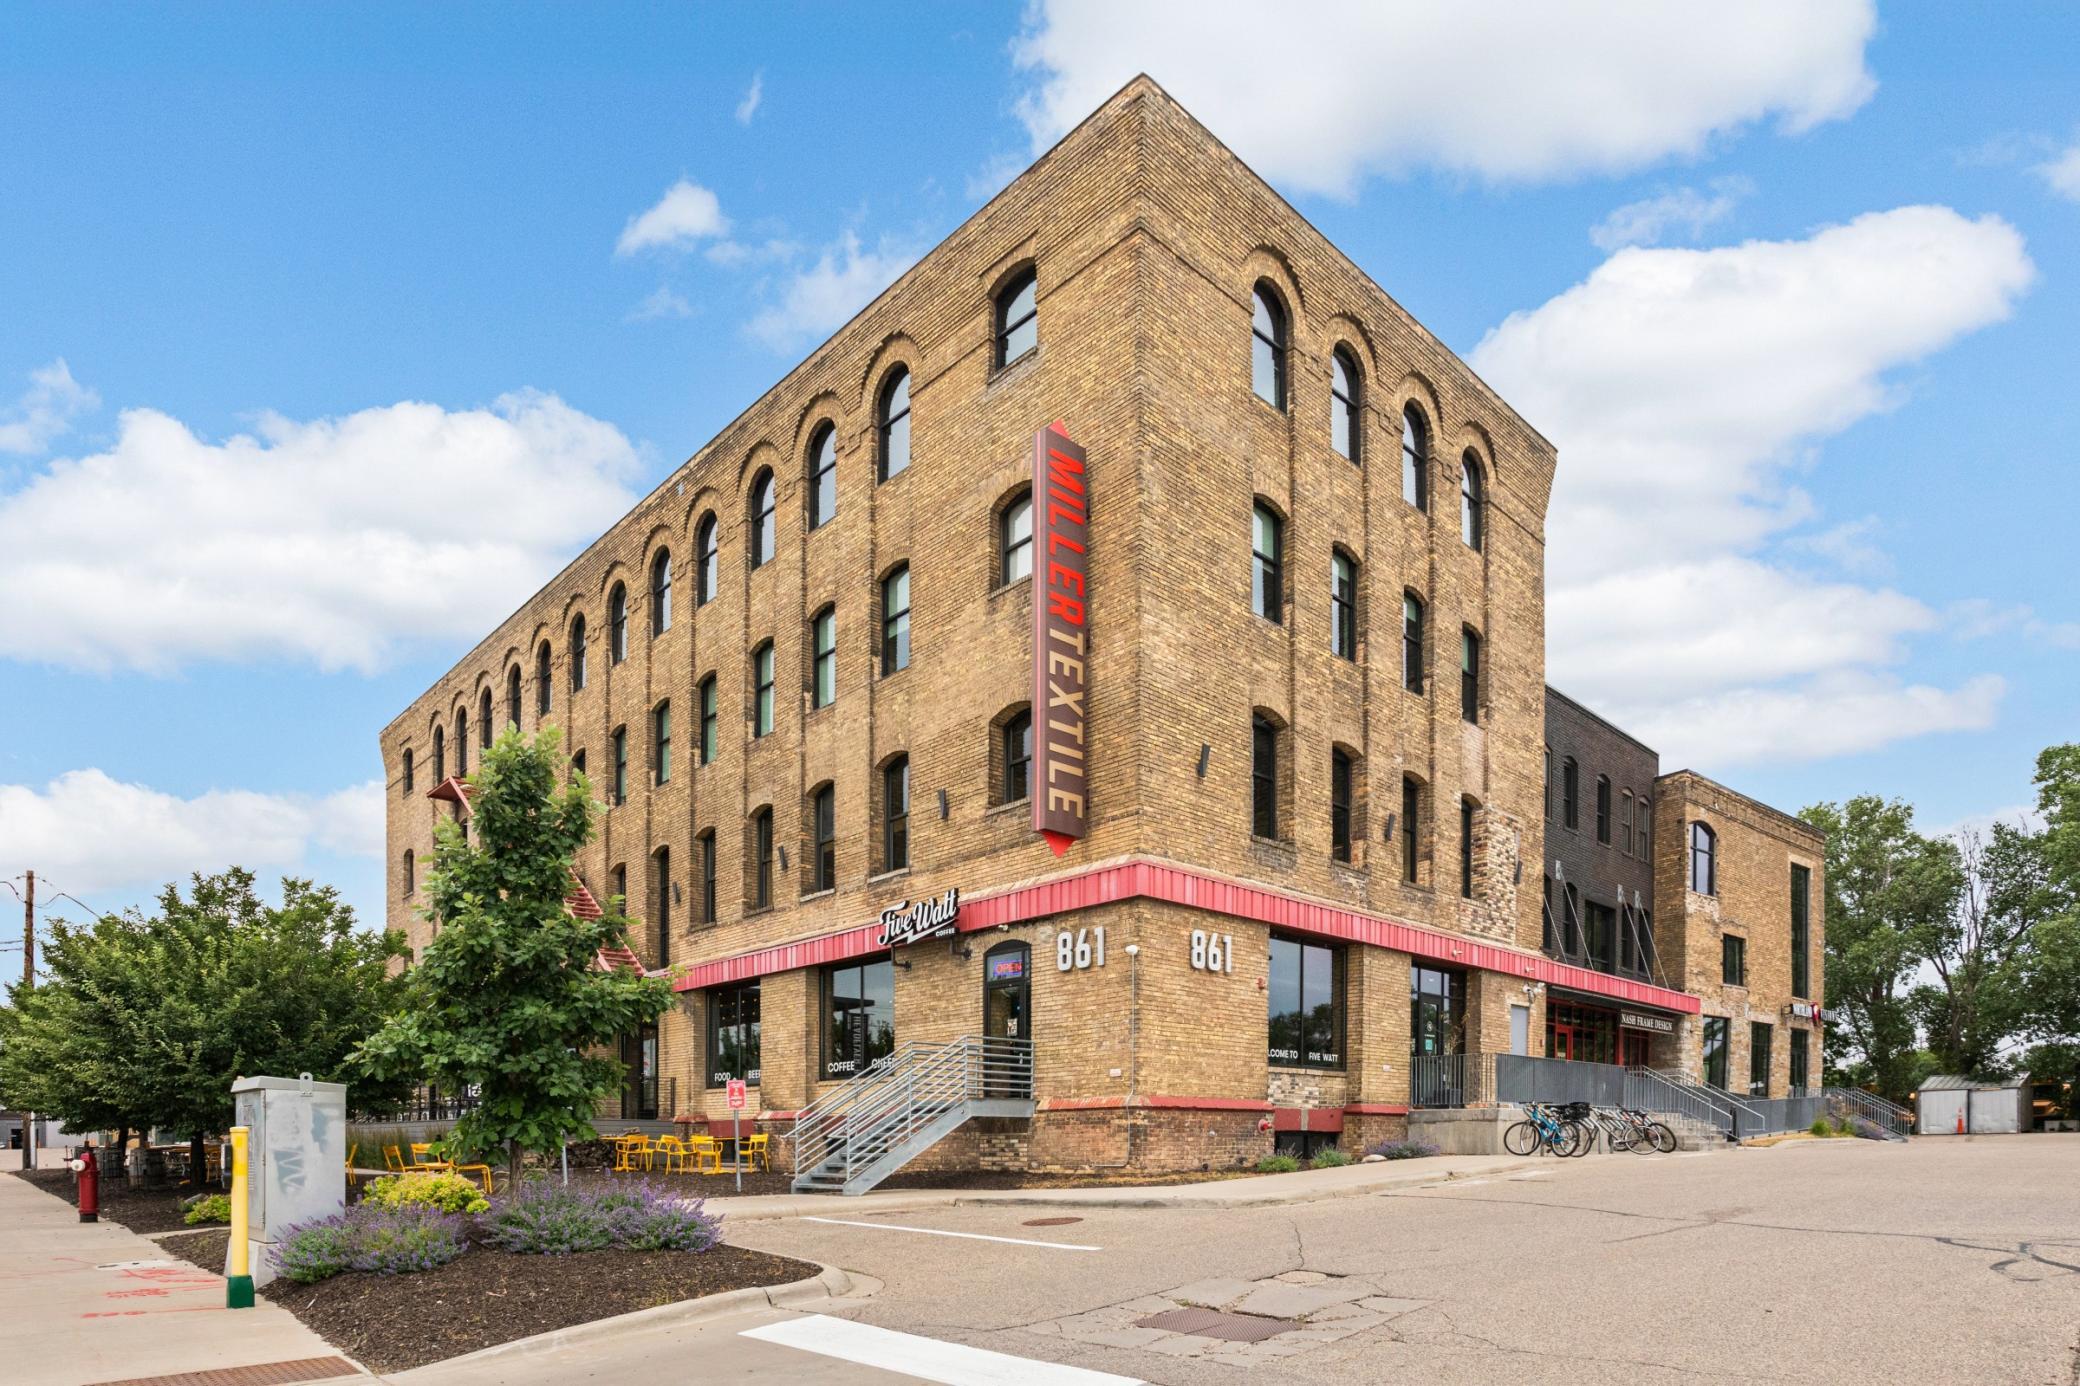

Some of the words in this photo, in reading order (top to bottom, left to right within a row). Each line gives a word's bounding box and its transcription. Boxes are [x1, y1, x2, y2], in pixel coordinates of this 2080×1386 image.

[1048, 447, 1085, 627] MILLER
[1049, 627, 1084, 819] TEXTILE
[877, 900, 913, 945] Five
[911, 888, 958, 932] Watt
[935, 927, 956, 937] COFFEE
[1057, 926, 1105, 971] 861
[1191, 929, 1232, 973] 861
[996, 962, 1022, 973] OPEN
[1621, 1013, 1636, 1025] NASH
[1637, 1016, 1654, 1028] FRAME
[1655, 1019, 1673, 1031] DESIGN
[1290, 1050, 1298, 1059] TO
[1309, 1052, 1320, 1060] FIVE
[1322, 1053, 1338, 1062] WATT
[827, 1060, 855, 1073] COFFEE
[871, 1057, 894, 1069] CHEE
[714, 1071, 731, 1082] FOOD
[747, 1069, 761, 1079] BEE
